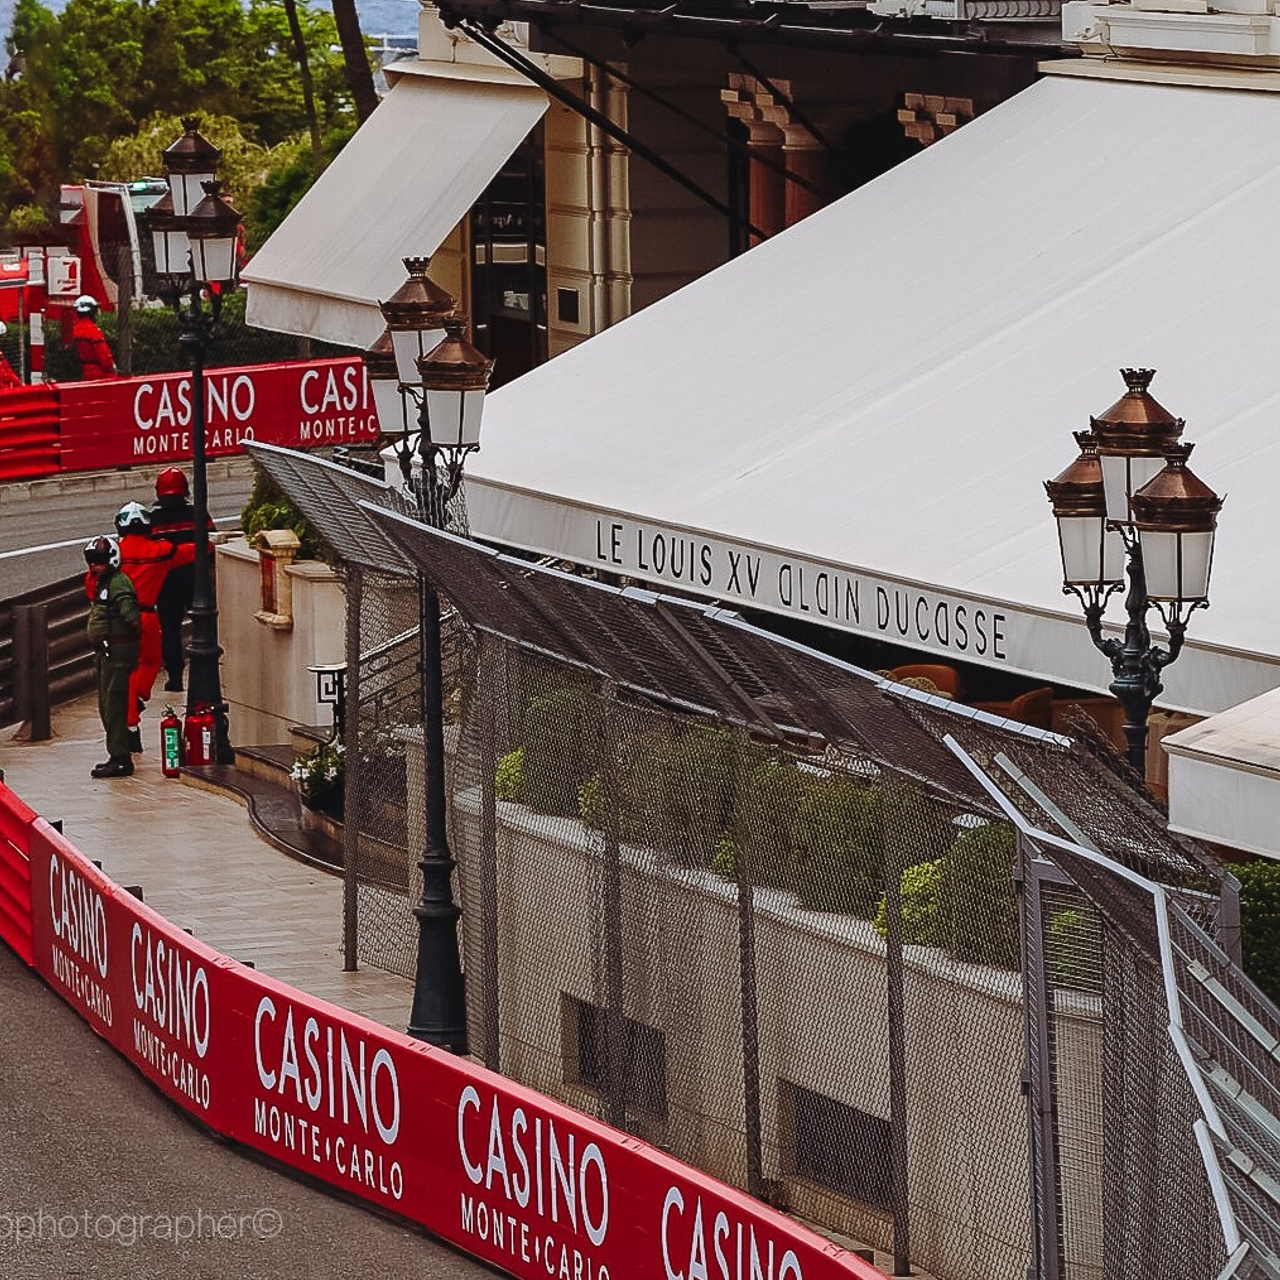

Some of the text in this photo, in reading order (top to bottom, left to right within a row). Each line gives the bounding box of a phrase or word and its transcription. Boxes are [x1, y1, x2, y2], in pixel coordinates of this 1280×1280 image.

[133, 375, 255, 430] CASNO
[133, 431, 190, 456] MONTE
[300, 417, 356, 440] MONTE
[596, 520, 623, 564] LE
[638, 529, 713, 586] LOUIS
[727, 550, 761, 598] XV
[50, 853, 108, 979] CASINO
[52, 944, 113, 1027] MONTE CARLO
[131, 922, 210, 1059] CASINO
[133, 1018, 210, 1110] MONTE CARLO
[254, 996, 401, 1145] CASINO
[254, 1097, 403, 1200] MONTE CARLO
[457, 1085, 609, 1247] CASINO
[461, 1192, 530, 1263] MONTE
